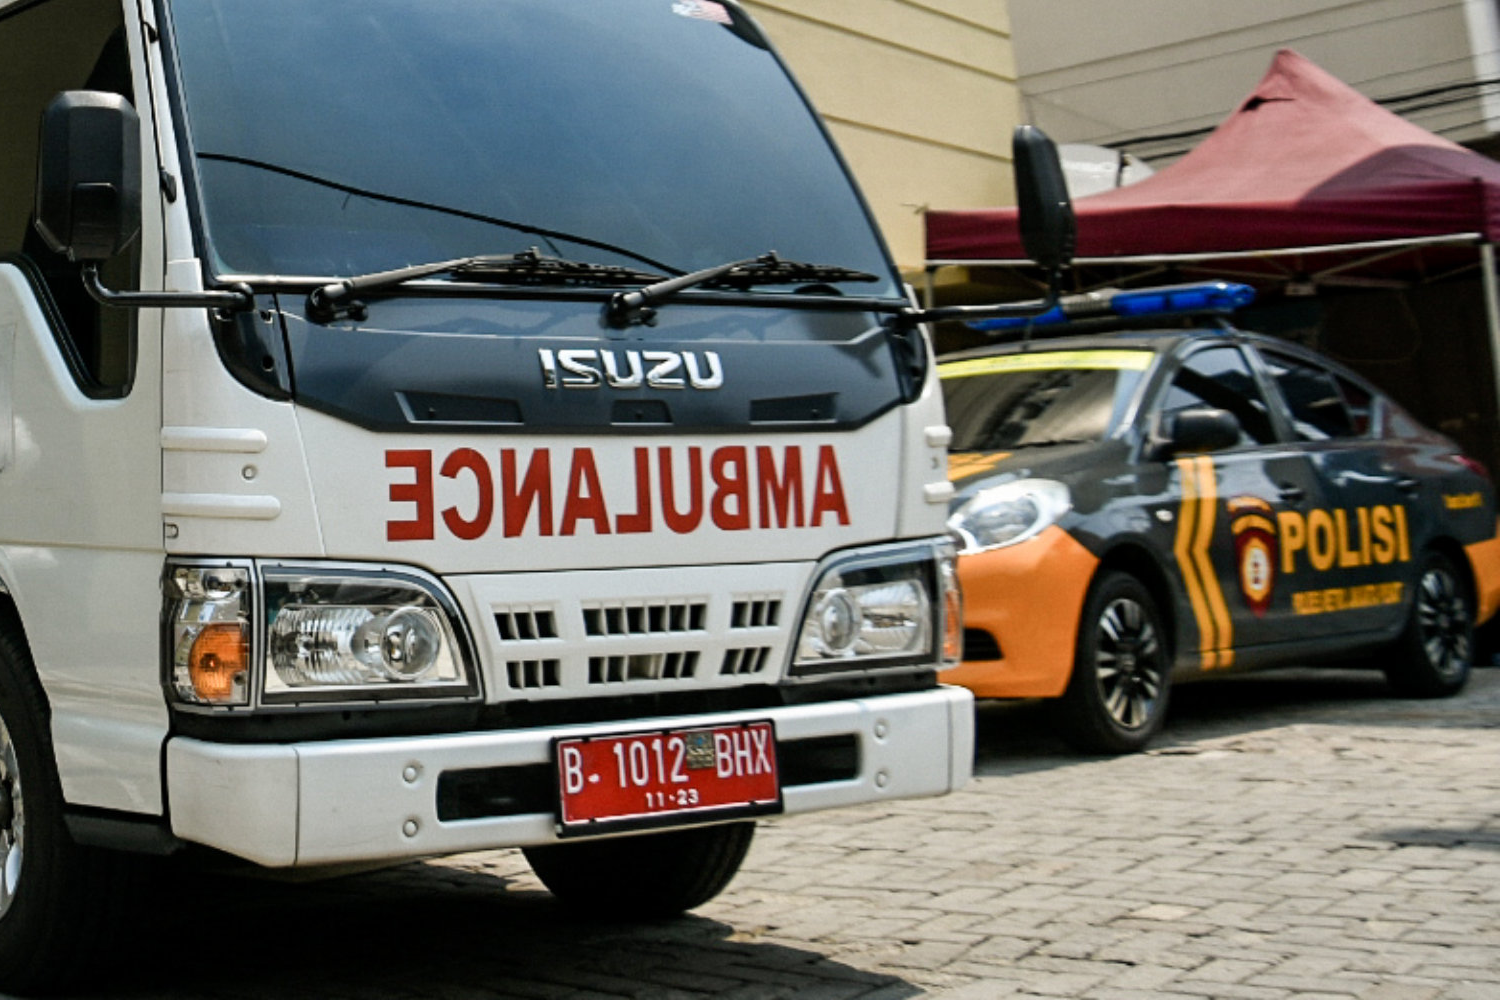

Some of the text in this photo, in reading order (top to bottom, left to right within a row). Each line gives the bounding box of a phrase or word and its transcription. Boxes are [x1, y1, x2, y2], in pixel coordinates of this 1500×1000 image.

[538, 348, 724, 389] ISUZU
[1277, 504, 1410, 574] POLISI
[613, 737, 690, 788] 1012
[714, 728, 772, 779] BHX
